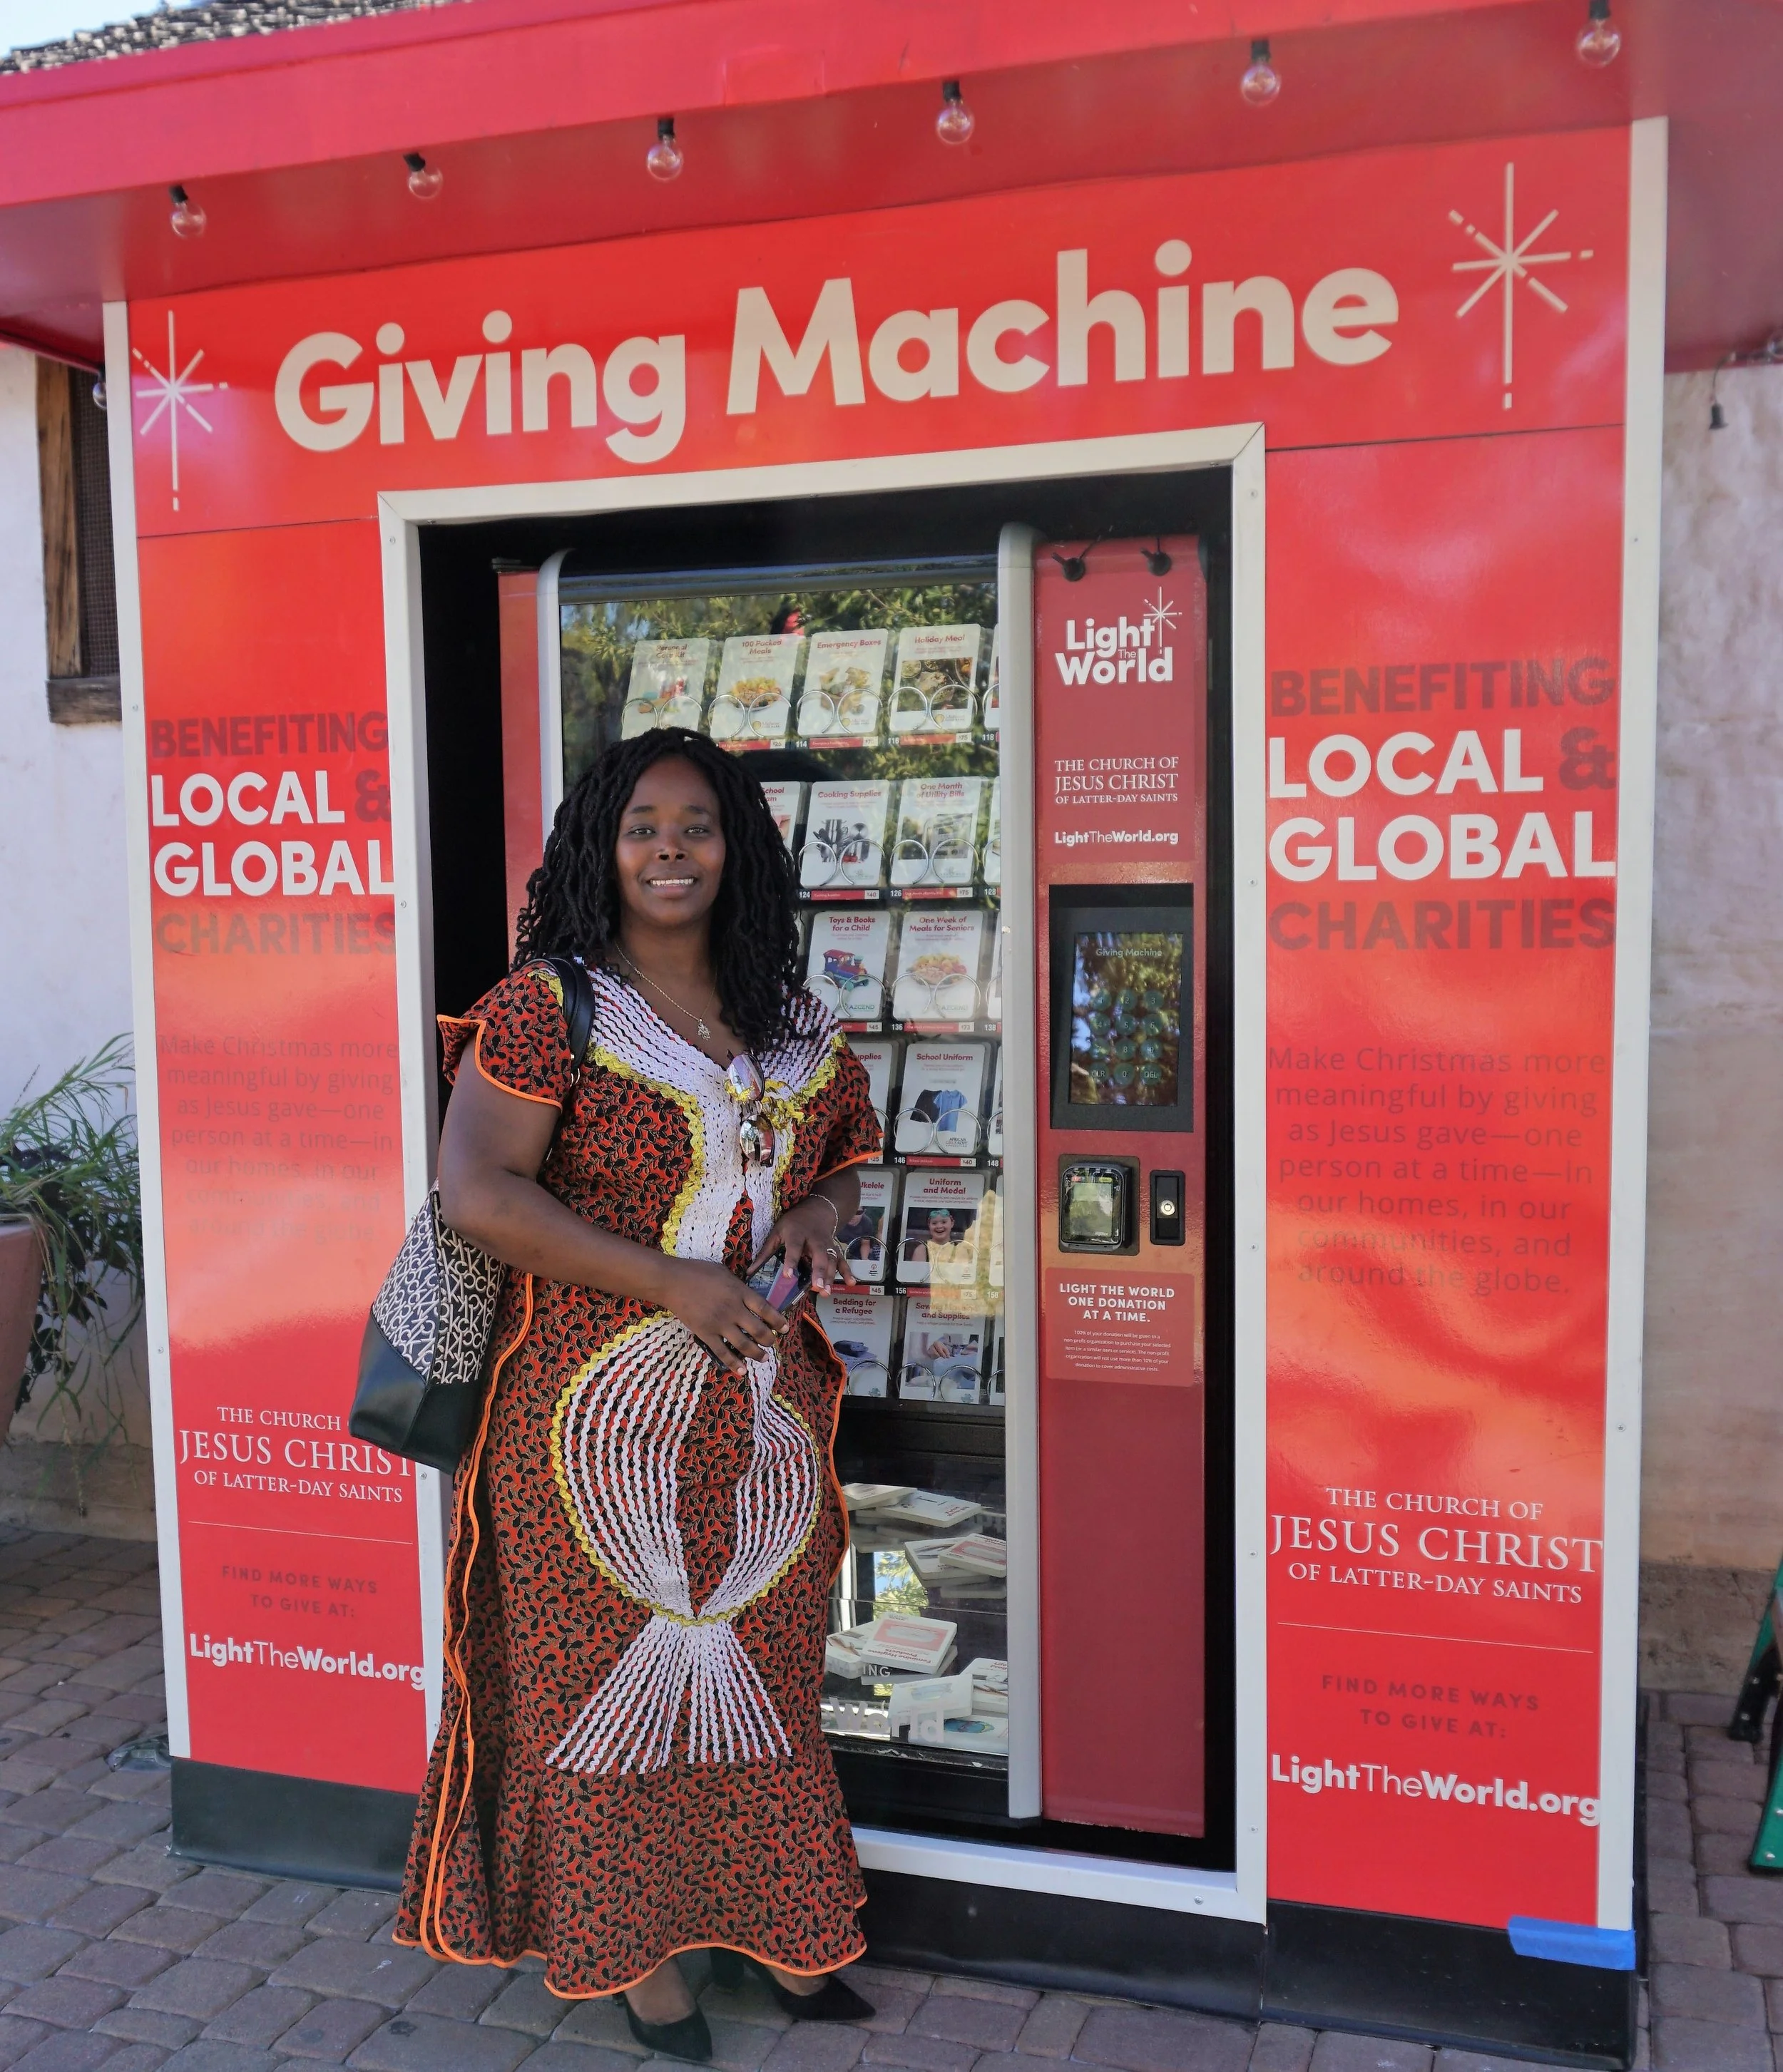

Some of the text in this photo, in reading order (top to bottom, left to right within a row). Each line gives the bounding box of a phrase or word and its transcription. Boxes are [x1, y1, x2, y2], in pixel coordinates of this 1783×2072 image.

[275, 239, 1400, 463] Giving Machine
[817, 640, 859, 650] Emergency
[914, 635, 943, 645] Holiday
[1066, 616, 1155, 658] Light
[1055, 647, 1173, 685] World
[1118, 649, 1136, 658] The
[1271, 656, 1615, 717] BENEFITING
[151, 712, 389, 758] BENEFITING
[1055, 757, 1179, 772] THE CHURCH OF
[1269, 727, 1616, 799] LOCAL &
[151, 769, 391, 826] LOCAL &
[818, 790, 882, 799] Cooking Supplies
[1055, 773, 1179, 795] JESUS CHRIST
[1056, 793, 1178, 804] OF LATTER-DAY SAINTS
[1055, 830, 1179, 847] LightTheWorld.org
[1269, 811, 1616, 882] GLOBAL
[154, 840, 394, 896] GLOBAL
[155, 912, 395, 955] CHARITIES
[1269, 898, 1615, 951] CHARITIES
[1095, 948, 1163, 958] Giving Machine
[1268, 1047, 1606, 1075] Make Christmas more
[1275, 1084, 1598, 1118] meaningful by giving
[1289, 1123, 1319, 1142] as
[1327, 1119, 1406, 1147] Jesus
[1279, 1157, 1381, 1184] person
[1393, 1158, 1419, 1180] at
[1433, 1161, 1448, 1179] a
[1298, 1191, 1572, 1221] our homes, in our
[1298, 1227, 1571, 1257] communities, and
[1060, 1283, 1175, 1298] LIGHT THE WORLD
[1298, 1261, 1570, 1297] around the globe.
[833, 1298, 863, 1307] Bedding
[842, 1307, 872, 1315] Refugee
[1068, 1297, 1166, 1310] ONE DONATION
[1083, 1311, 1150, 1323] AT A TIME.
[218, 1407, 342, 1430] THE CHURCH
[180, 1430, 271, 1465] JESUS
[194, 1470, 402, 1503] OF LATTER-DAY SAINTS
[1326, 1487, 1543, 1521] THE CHURCH OF
[1270, 1514, 1603, 1573] JESUS CHRIST
[223, 1566, 378, 1594] FIND MORE WAYS
[1289, 1562, 1583, 1604] OF LATTER-DAY SAINTS
[250, 1594, 355, 1618] TO GIVE AT:
[190, 1633, 425, 1691] LightTheWorld.org
[1322, 1675, 1540, 1711] FIND MORE WAYS
[1360, 1708, 1507, 1739] TO GIVE AT:
[1272, 1754, 1601, 1827] LightTheWorld.org
